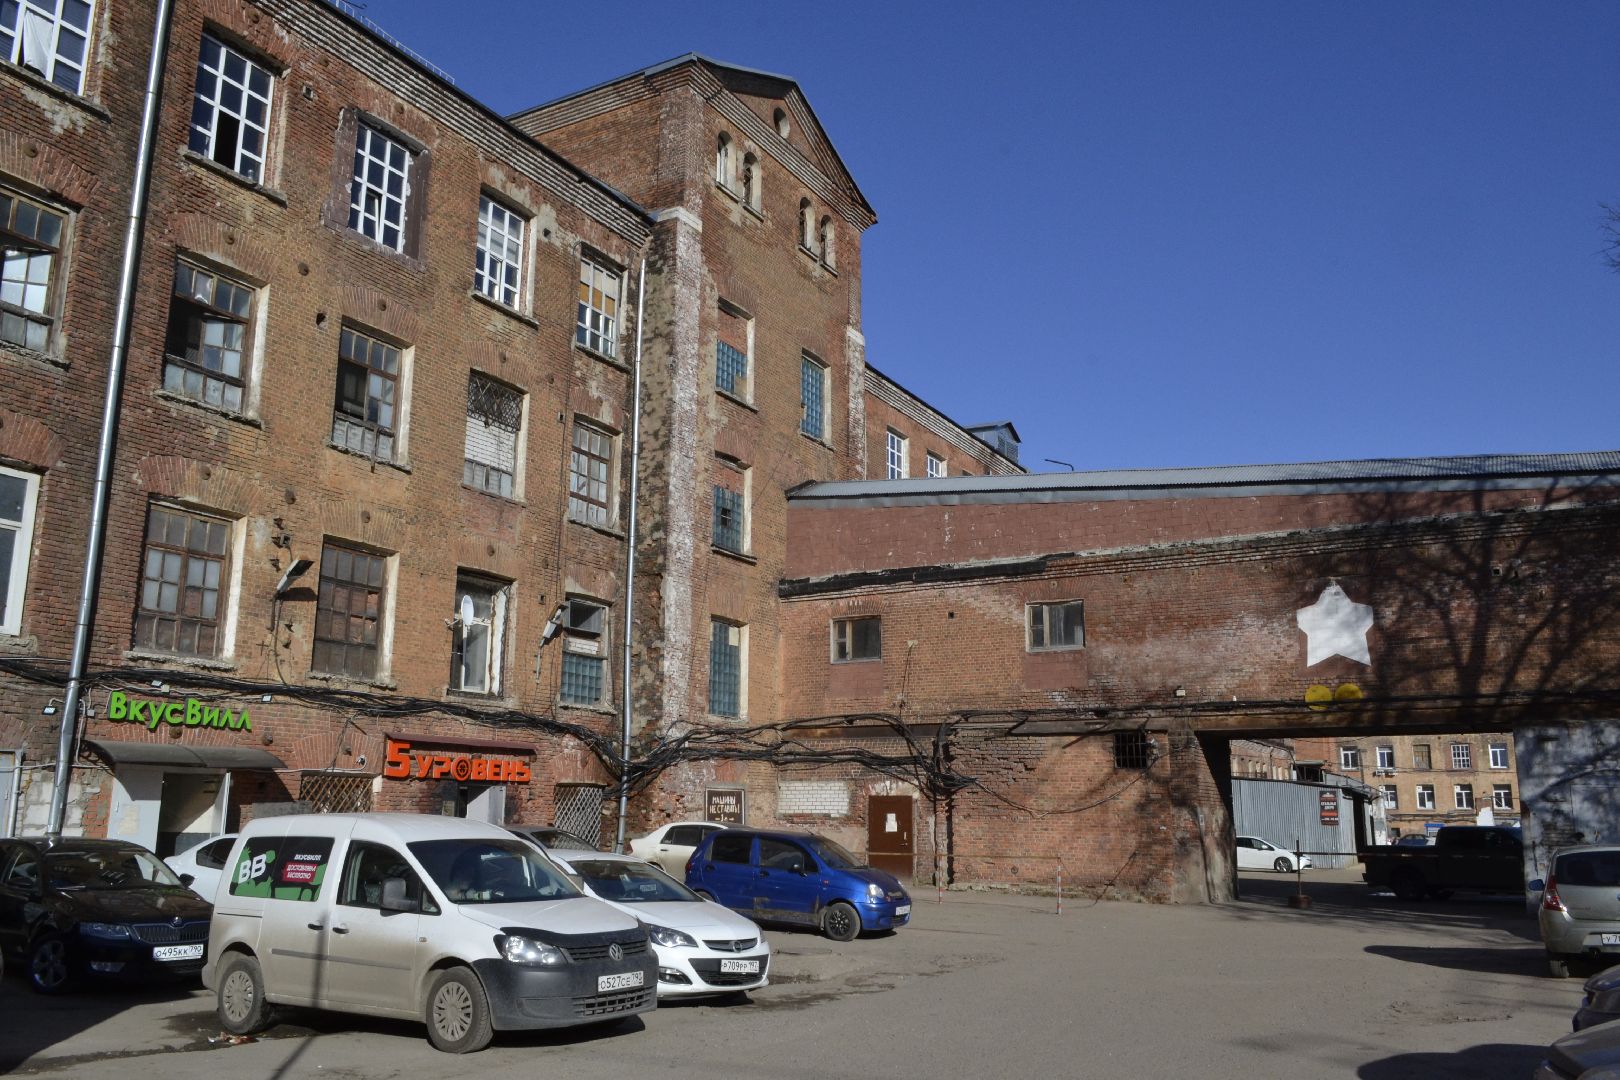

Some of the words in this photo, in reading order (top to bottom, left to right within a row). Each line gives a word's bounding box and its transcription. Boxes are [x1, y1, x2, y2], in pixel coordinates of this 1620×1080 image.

[108, 691, 252, 730] ВкусВилл
[385, 740, 410, 778] 5
[415, 754, 531, 782] УРОВЕНЬ
